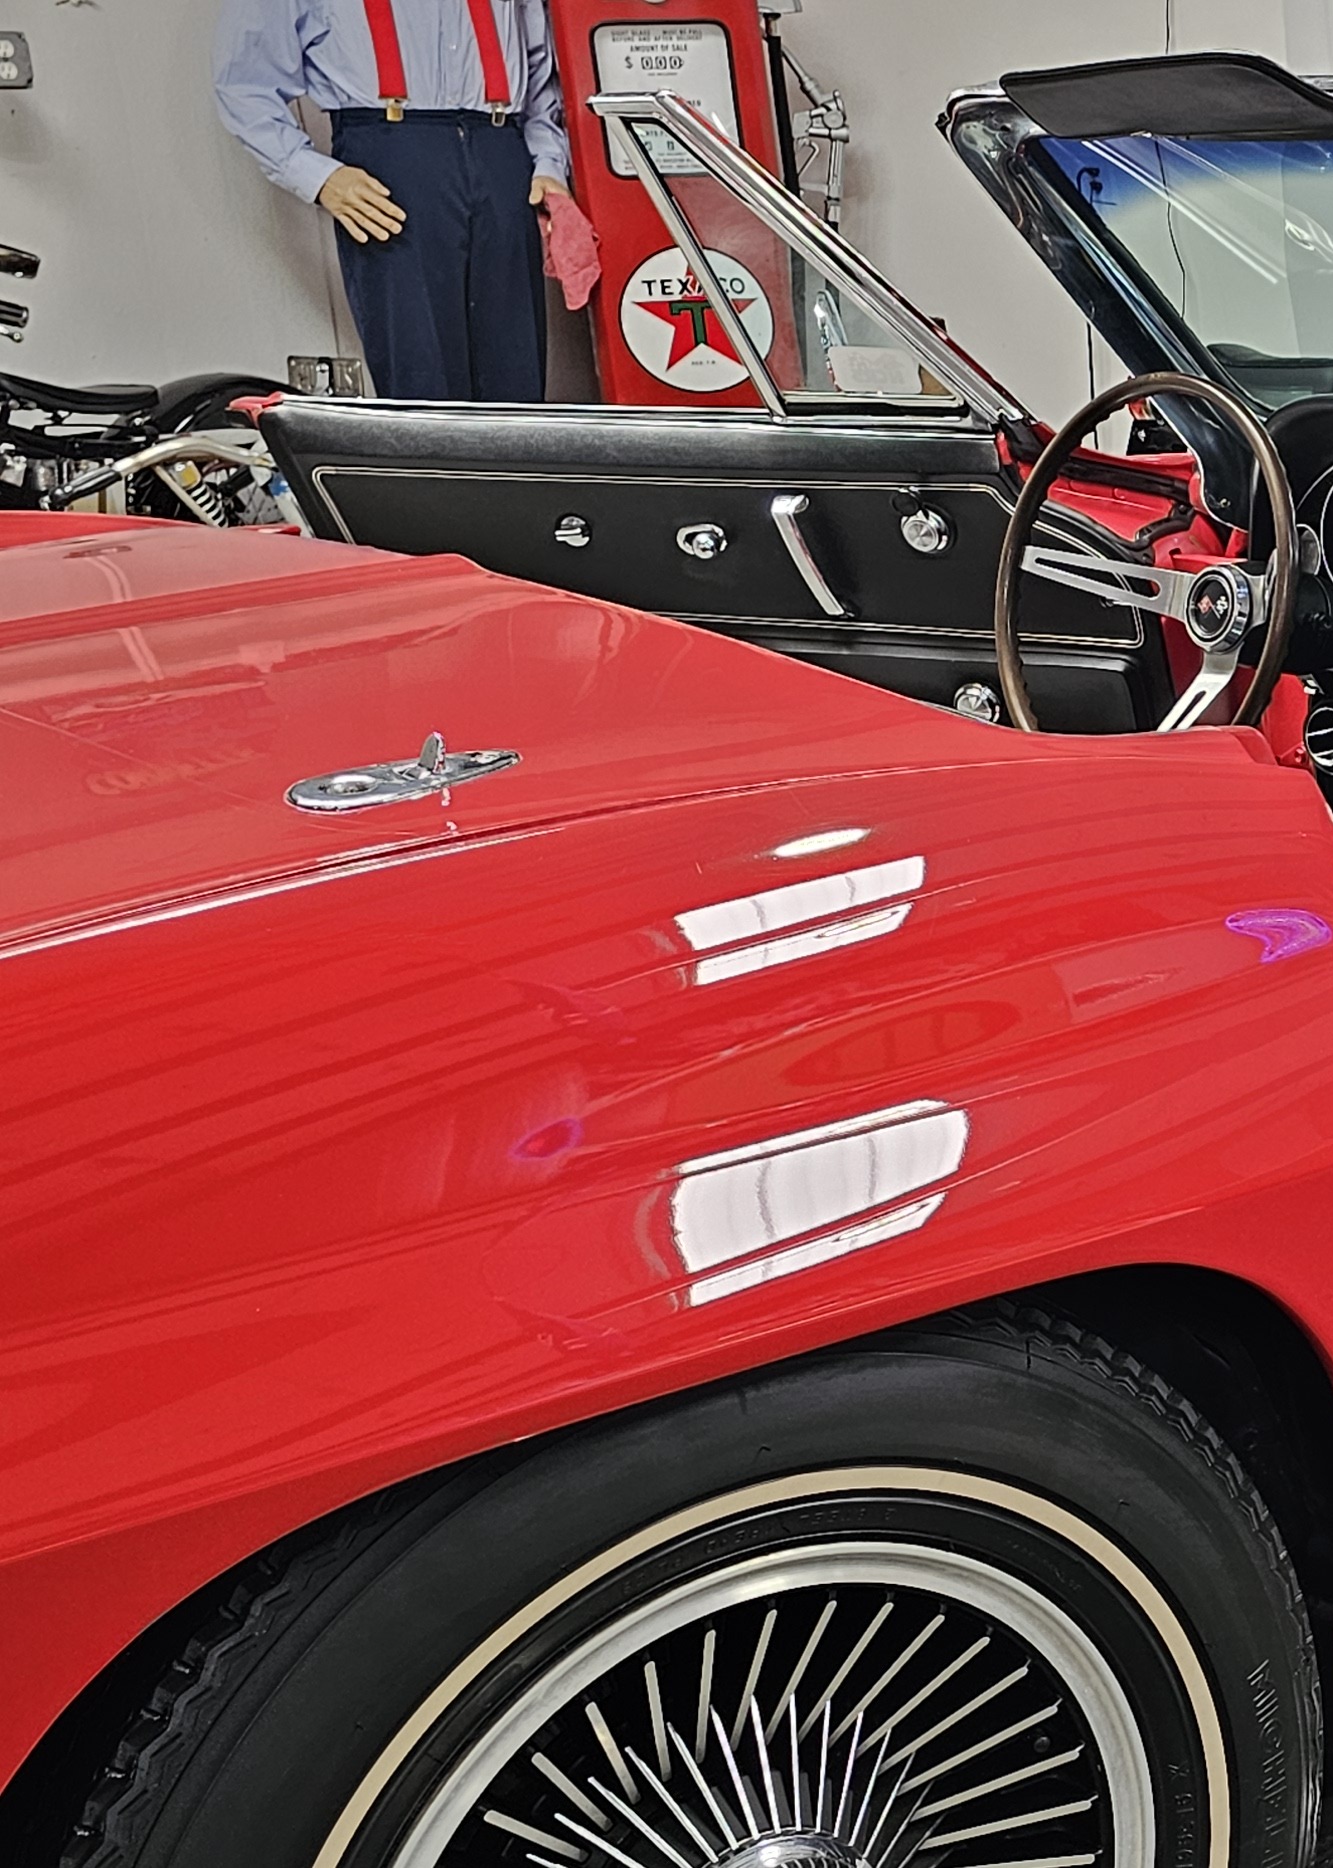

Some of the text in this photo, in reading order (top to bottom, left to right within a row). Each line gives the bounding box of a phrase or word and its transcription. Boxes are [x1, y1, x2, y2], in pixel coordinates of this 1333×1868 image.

[625, 56, 633, 69] $
[641, 276, 746, 297] TEXCO
[1246, 1658, 1288, 1868] MICHELI
